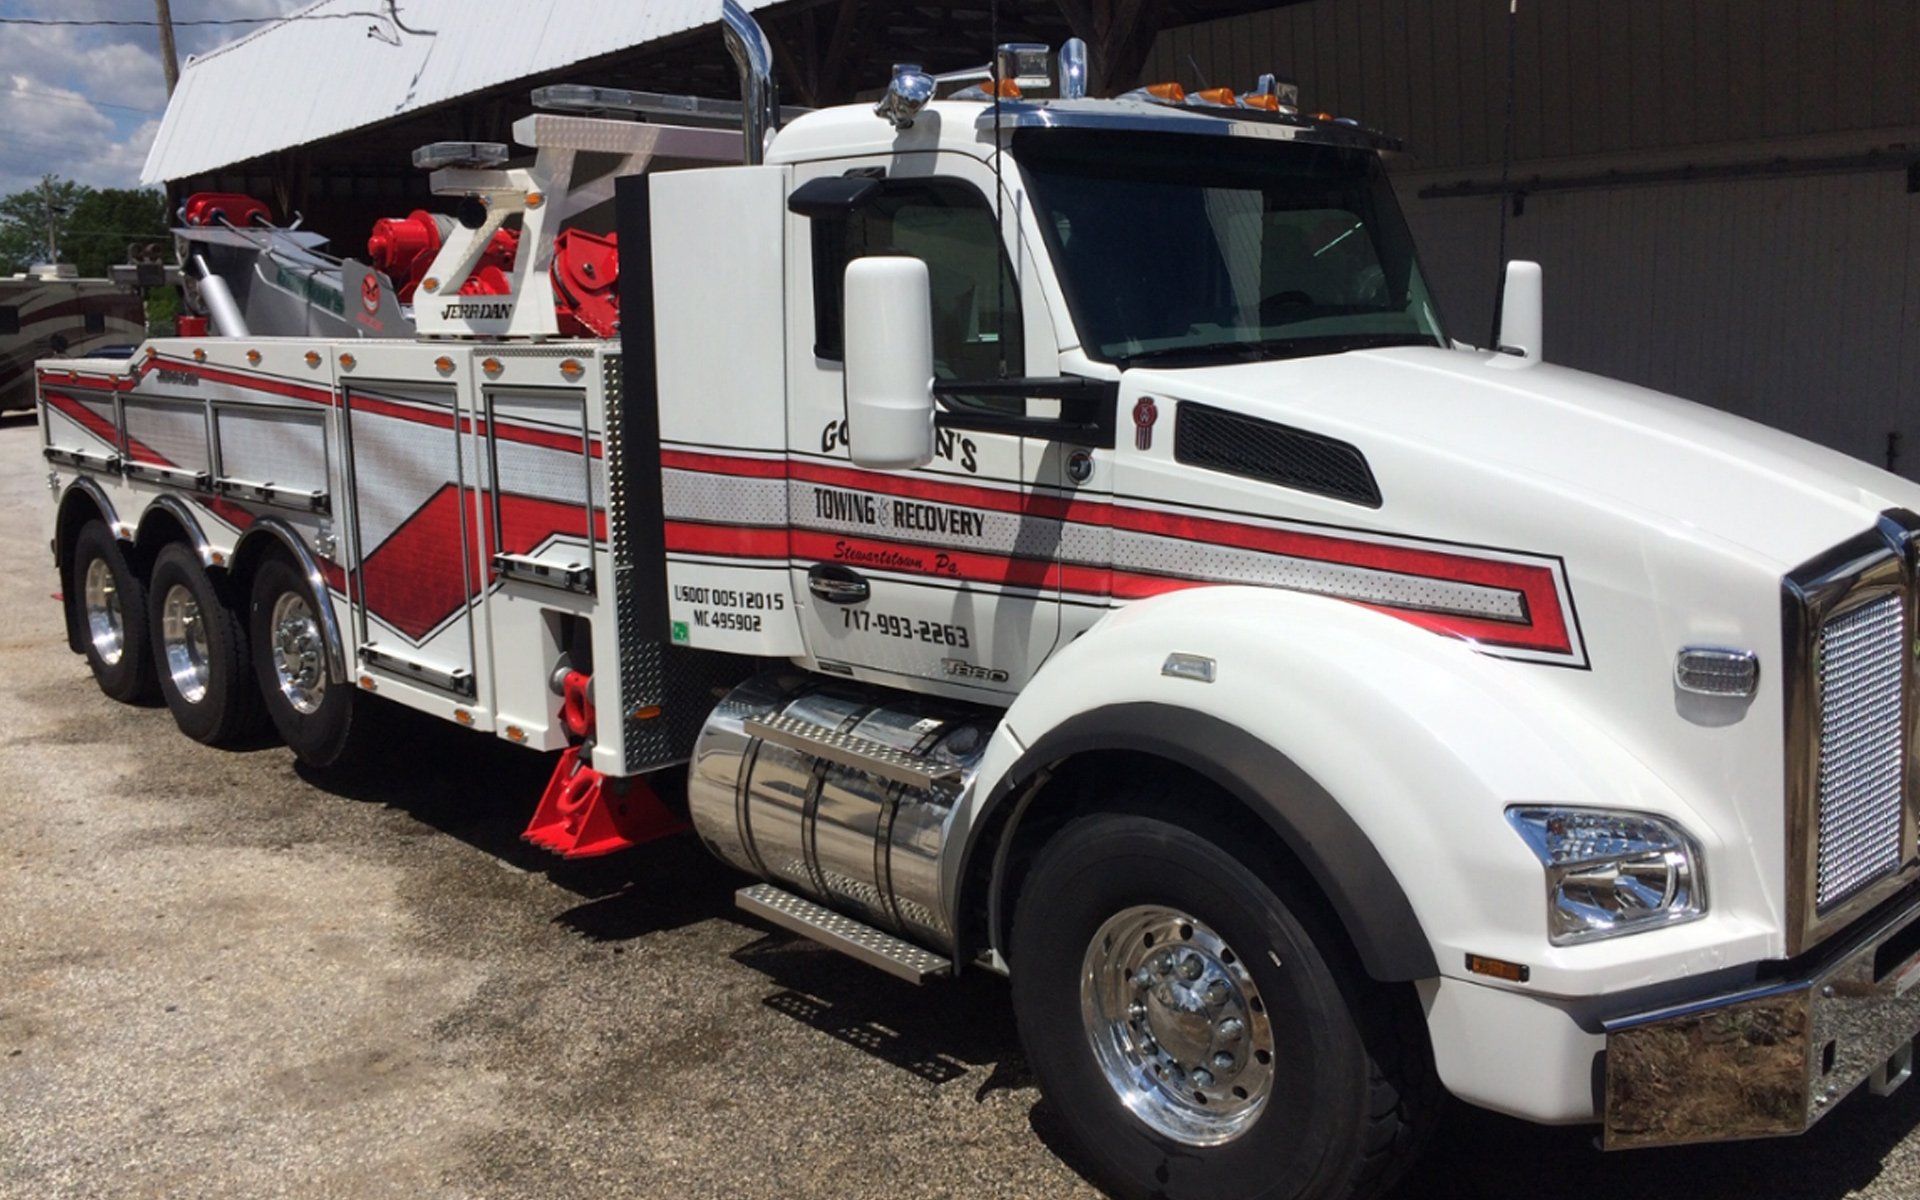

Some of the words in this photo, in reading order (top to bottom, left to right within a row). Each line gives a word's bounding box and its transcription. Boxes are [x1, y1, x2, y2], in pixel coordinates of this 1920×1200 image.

[821, 419, 977, 474] GON'S
[814, 487, 875, 525] TOWING
[893, 500, 986, 537] RECOVERY
[711, 610, 762, 632] 495902
[712, 588, 784, 611] 00512015
[840, 606, 969, 649] 717-993-2263
